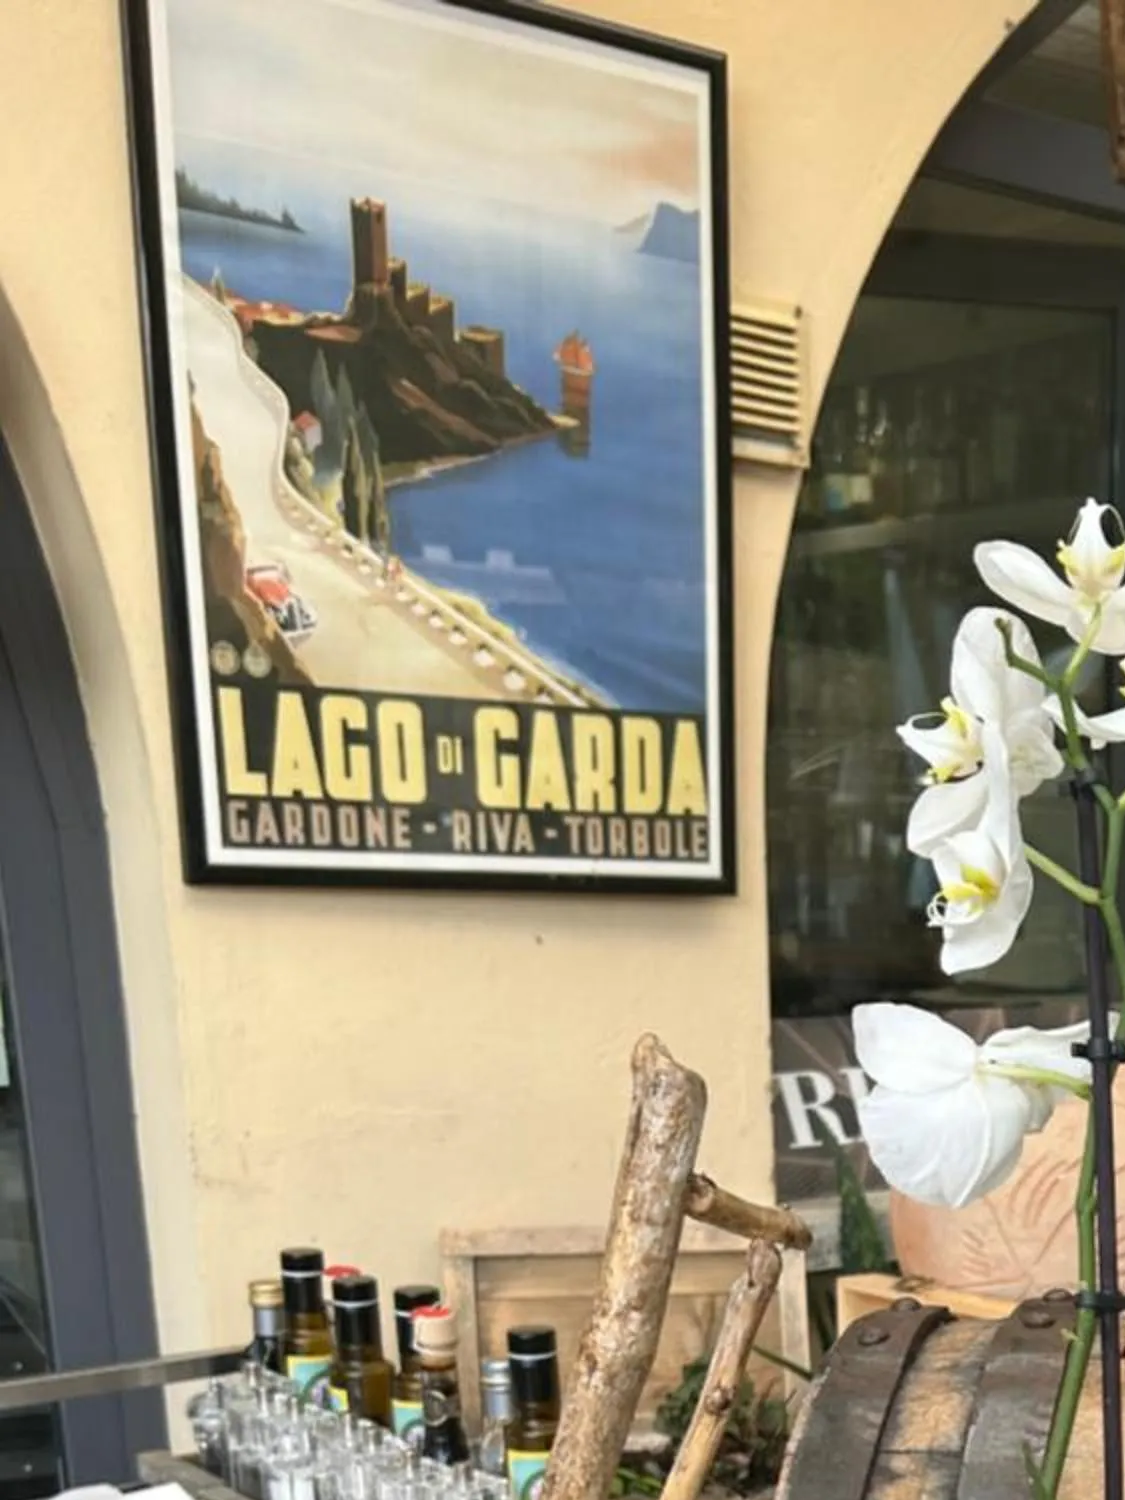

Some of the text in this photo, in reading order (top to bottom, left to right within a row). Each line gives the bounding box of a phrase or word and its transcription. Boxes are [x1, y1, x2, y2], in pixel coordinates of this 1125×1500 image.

[218, 687, 708, 815] LAGO DI GARDA
[226, 801, 412, 849] GARDONE
[452, 811, 534, 853] RIVA
[564, 815, 708, 859] TORBOLE
